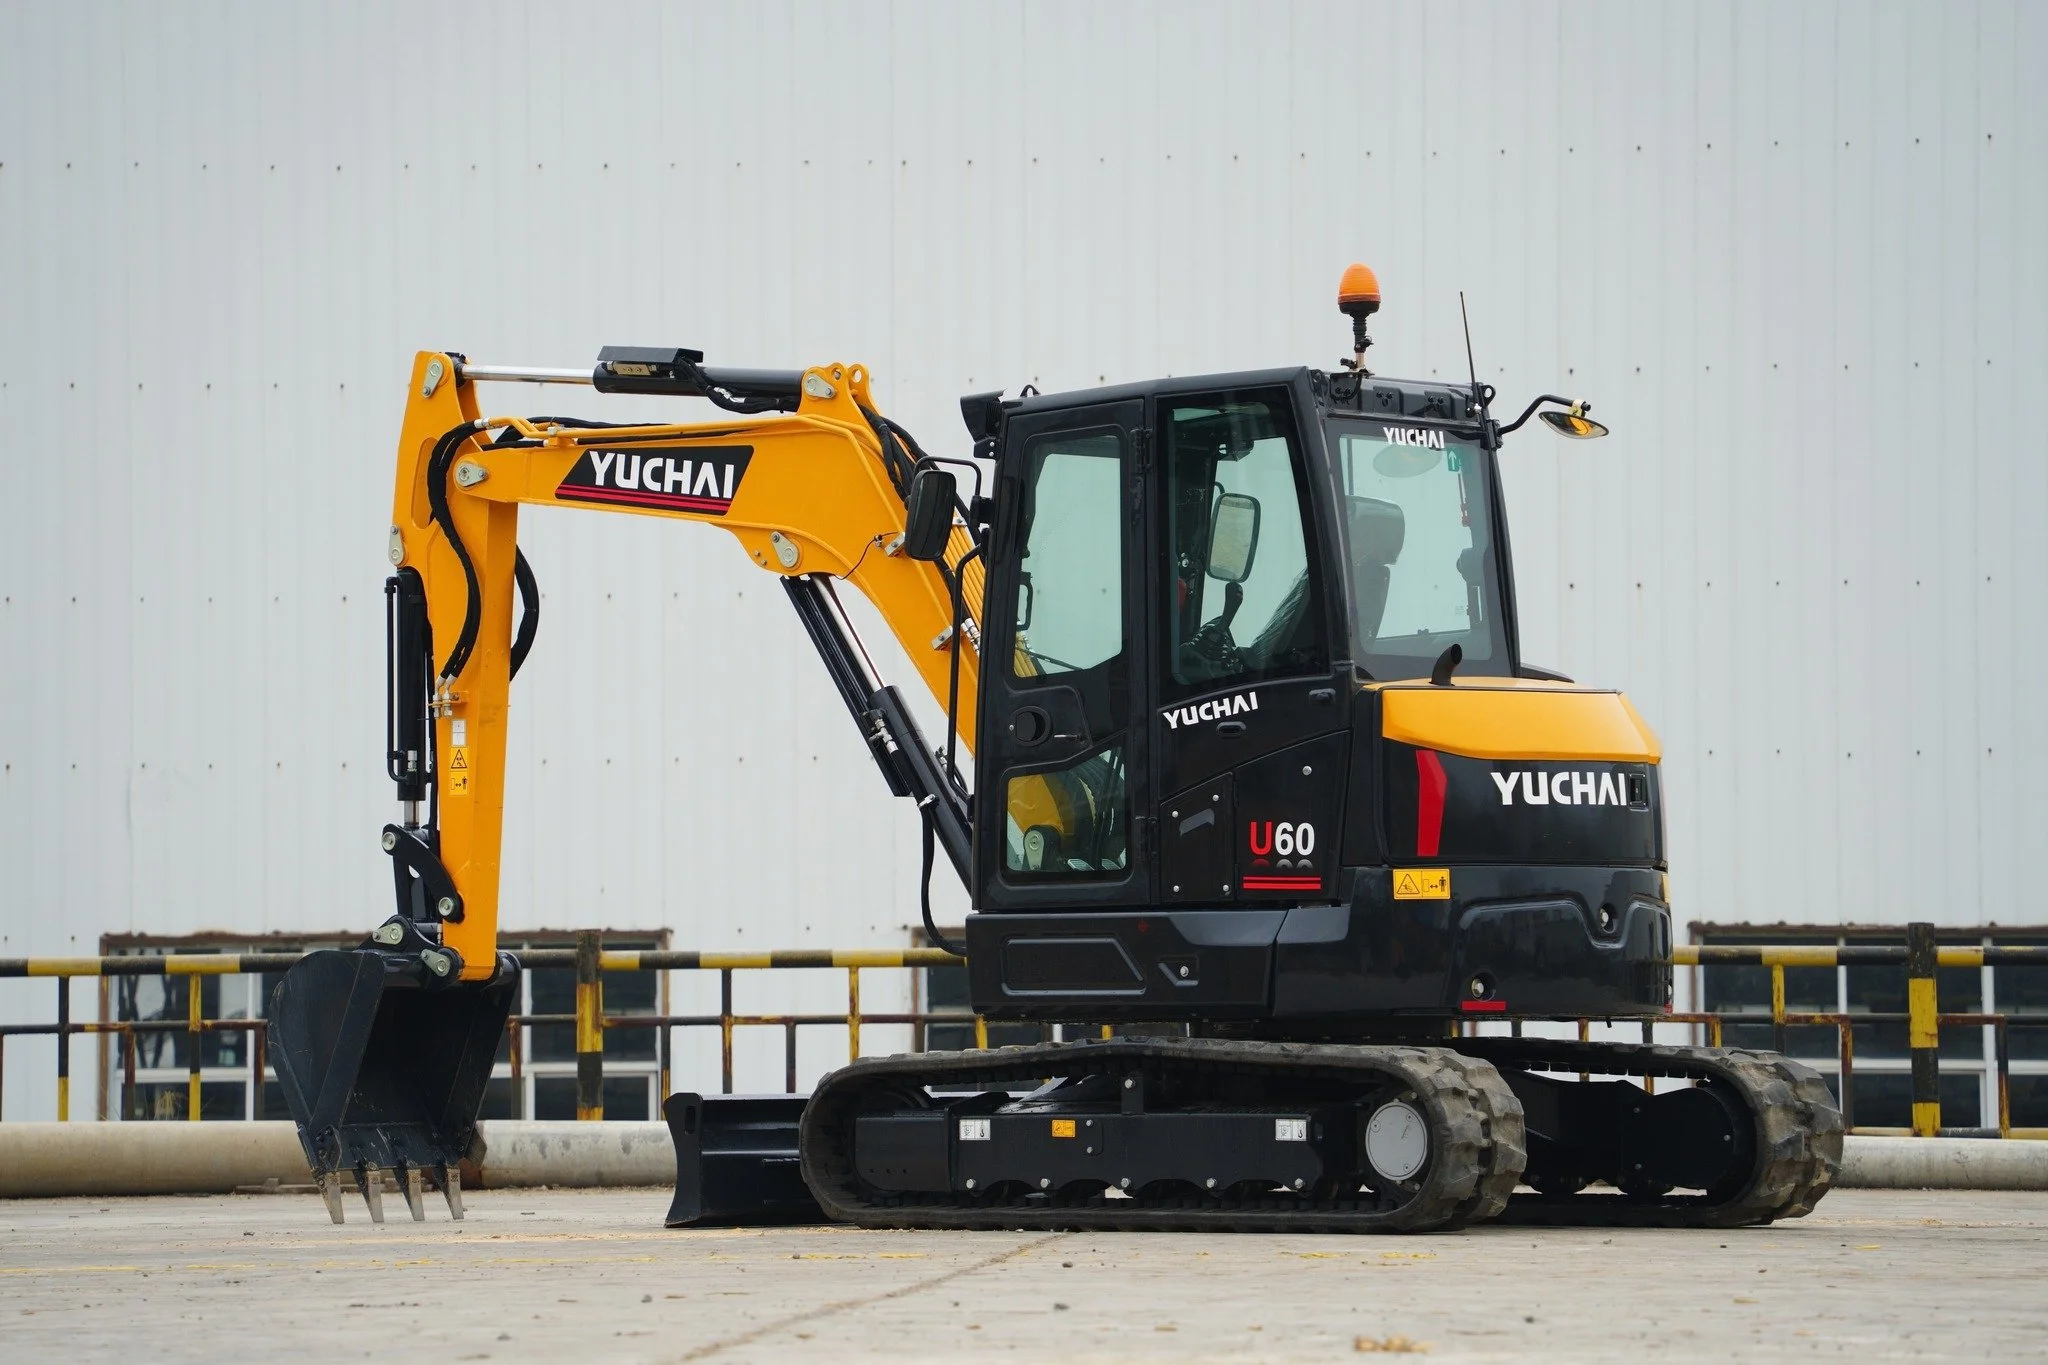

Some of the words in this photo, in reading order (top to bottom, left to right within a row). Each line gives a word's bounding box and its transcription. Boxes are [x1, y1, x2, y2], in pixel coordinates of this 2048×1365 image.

[1383, 427, 1445, 449] YUCHAI
[589, 451, 735, 499] YUCHAI
[1162, 691, 1259, 730] YUCHAI
[1490, 771, 1627, 806] YUCHAI
[1250, 821, 1315, 856] U60
